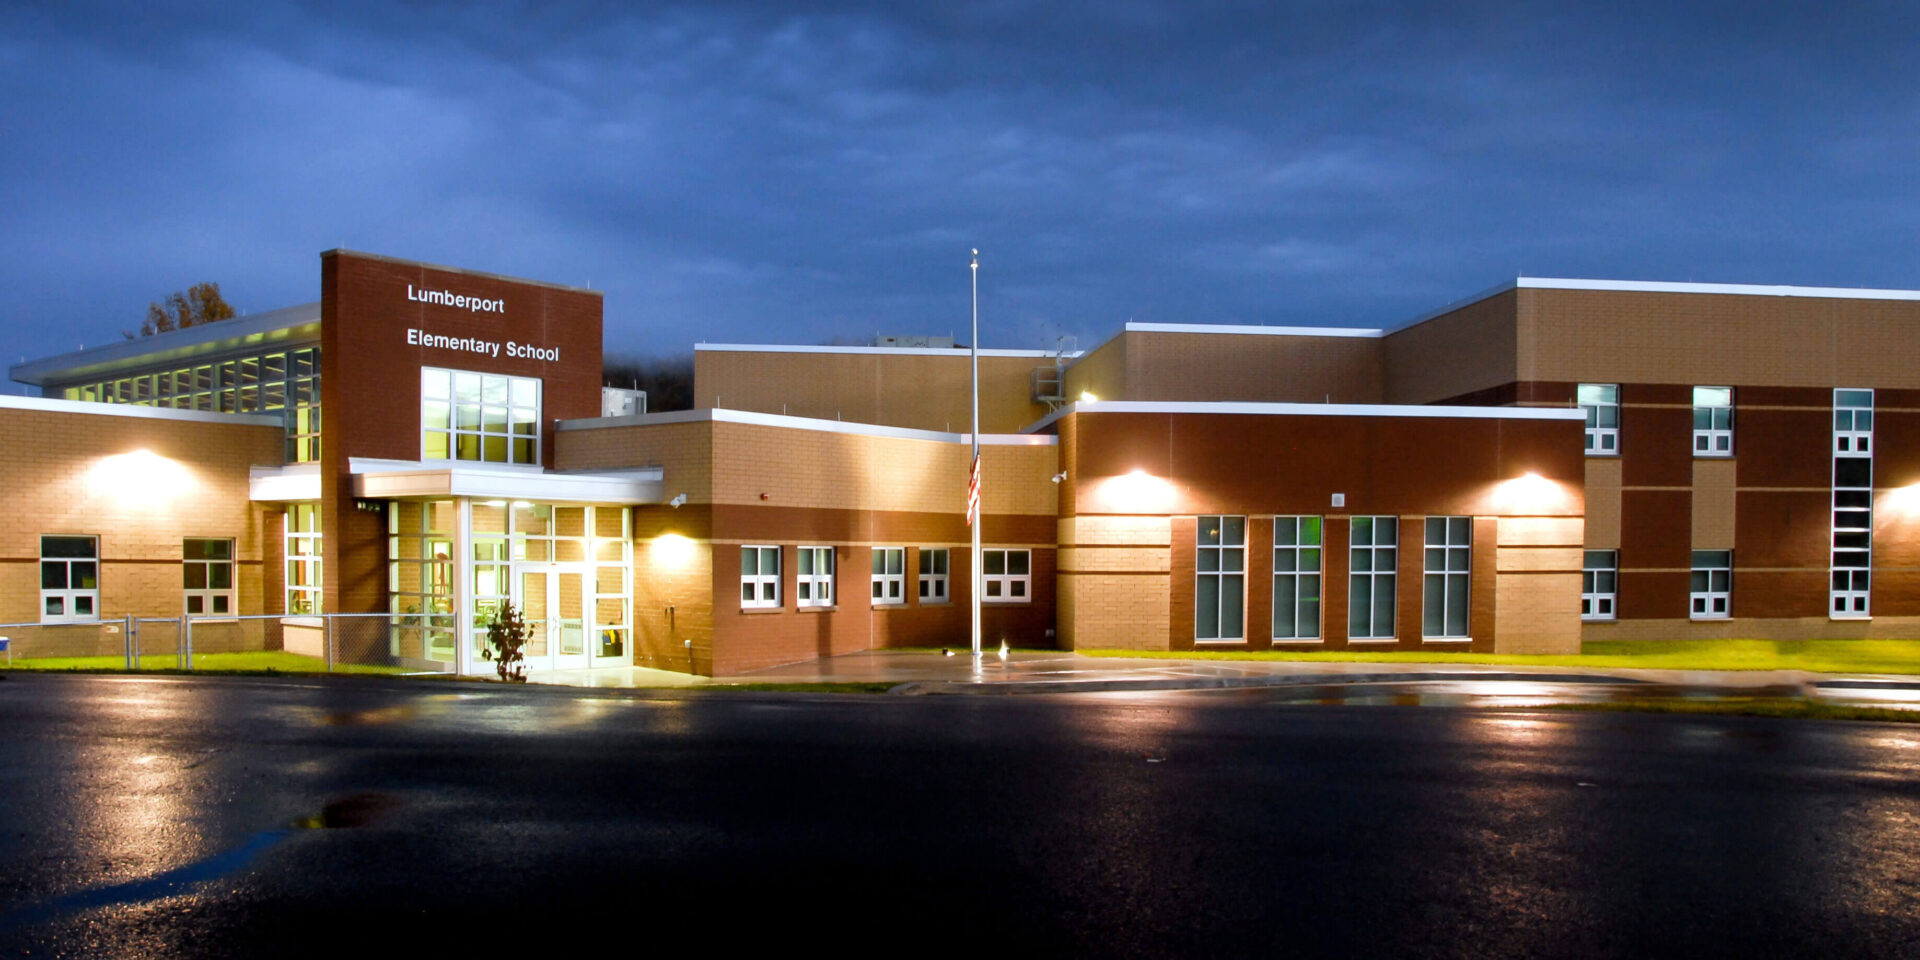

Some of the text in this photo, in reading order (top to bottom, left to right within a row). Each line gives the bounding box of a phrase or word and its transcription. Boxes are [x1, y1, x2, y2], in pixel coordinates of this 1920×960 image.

[407, 284, 505, 313] Lumberport
[407, 328, 559, 362] Elementary School
